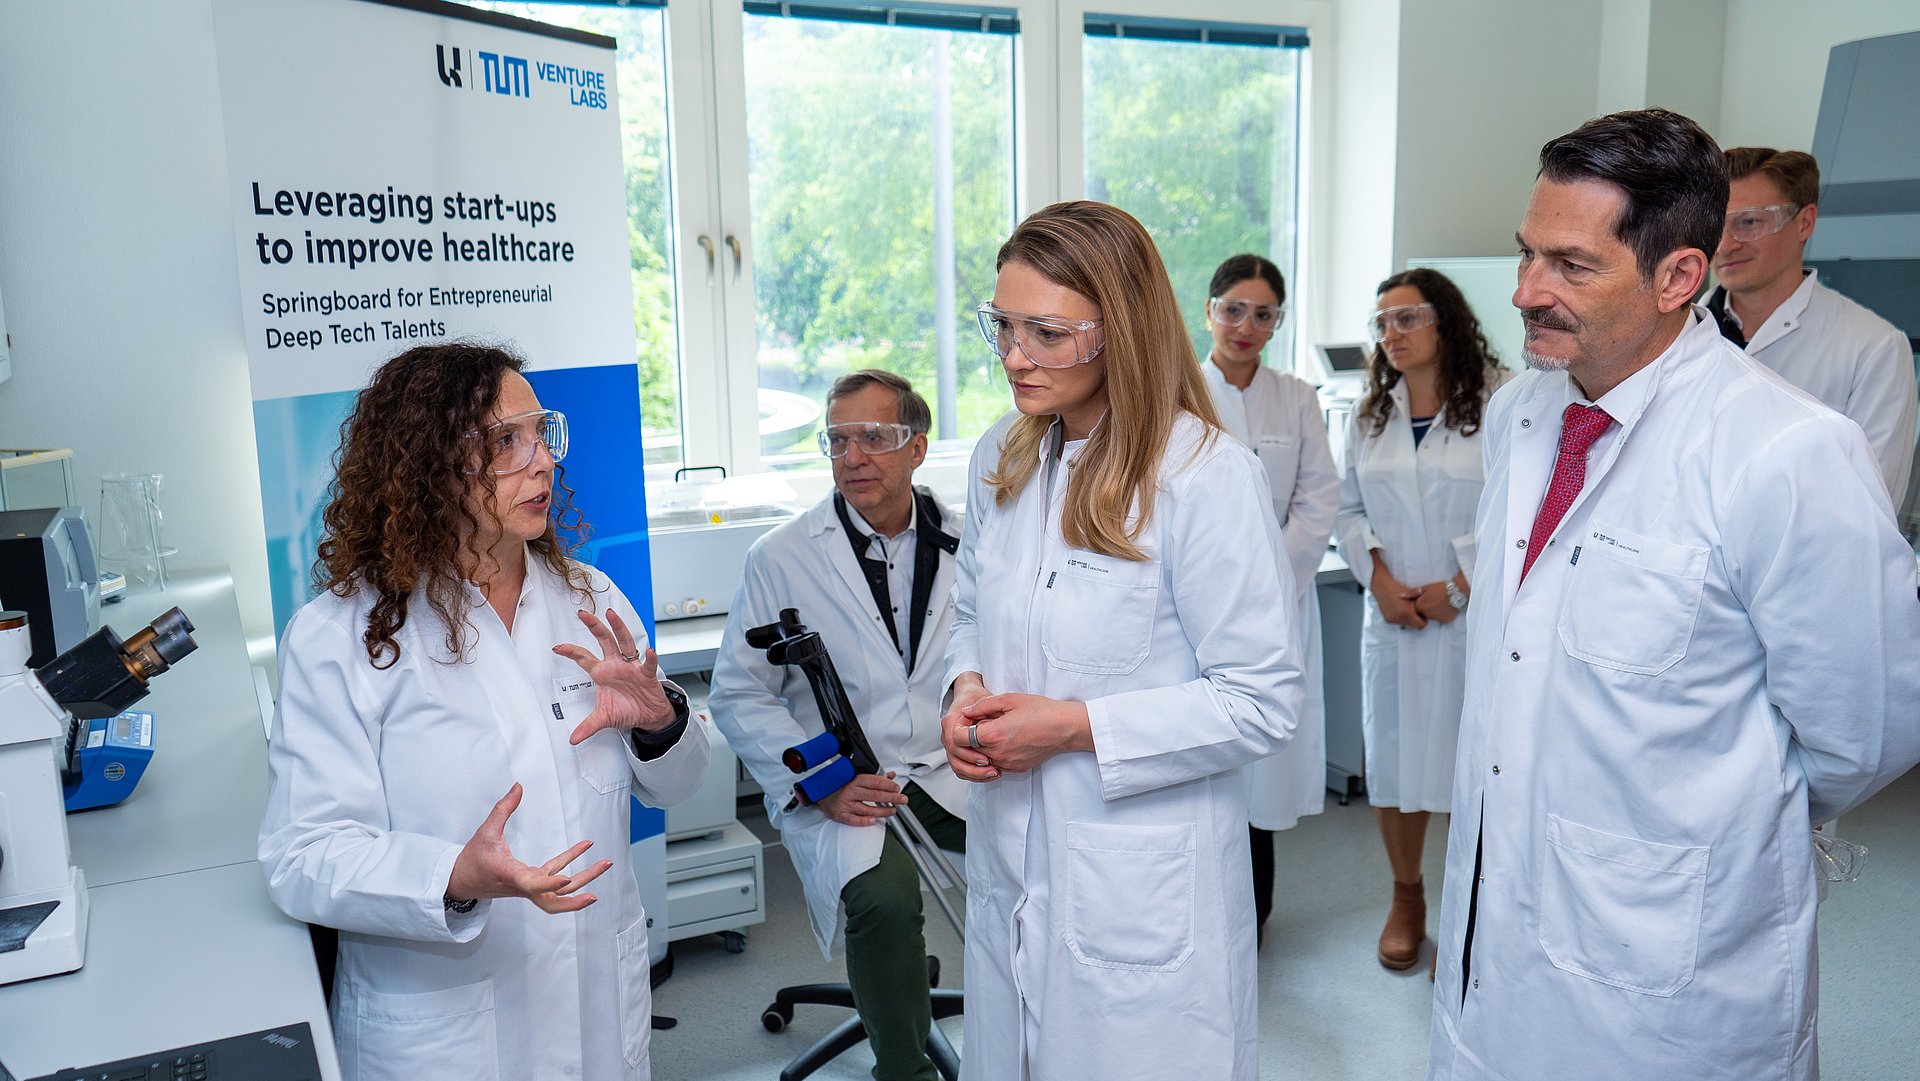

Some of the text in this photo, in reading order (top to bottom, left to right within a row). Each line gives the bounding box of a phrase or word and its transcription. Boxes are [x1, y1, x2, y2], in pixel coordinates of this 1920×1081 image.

[478, 51, 530, 98] TUM
[536, 61, 605, 91] VENTURE
[570, 87, 607, 110] LABS
[252, 181, 557, 228] Leveraging start-ups
[256, 230, 575, 270] to improve healthcare
[262, 284, 553, 317] Springboard for Entrepreneurial
[265, 318, 446, 351] Deep Tech Talents
